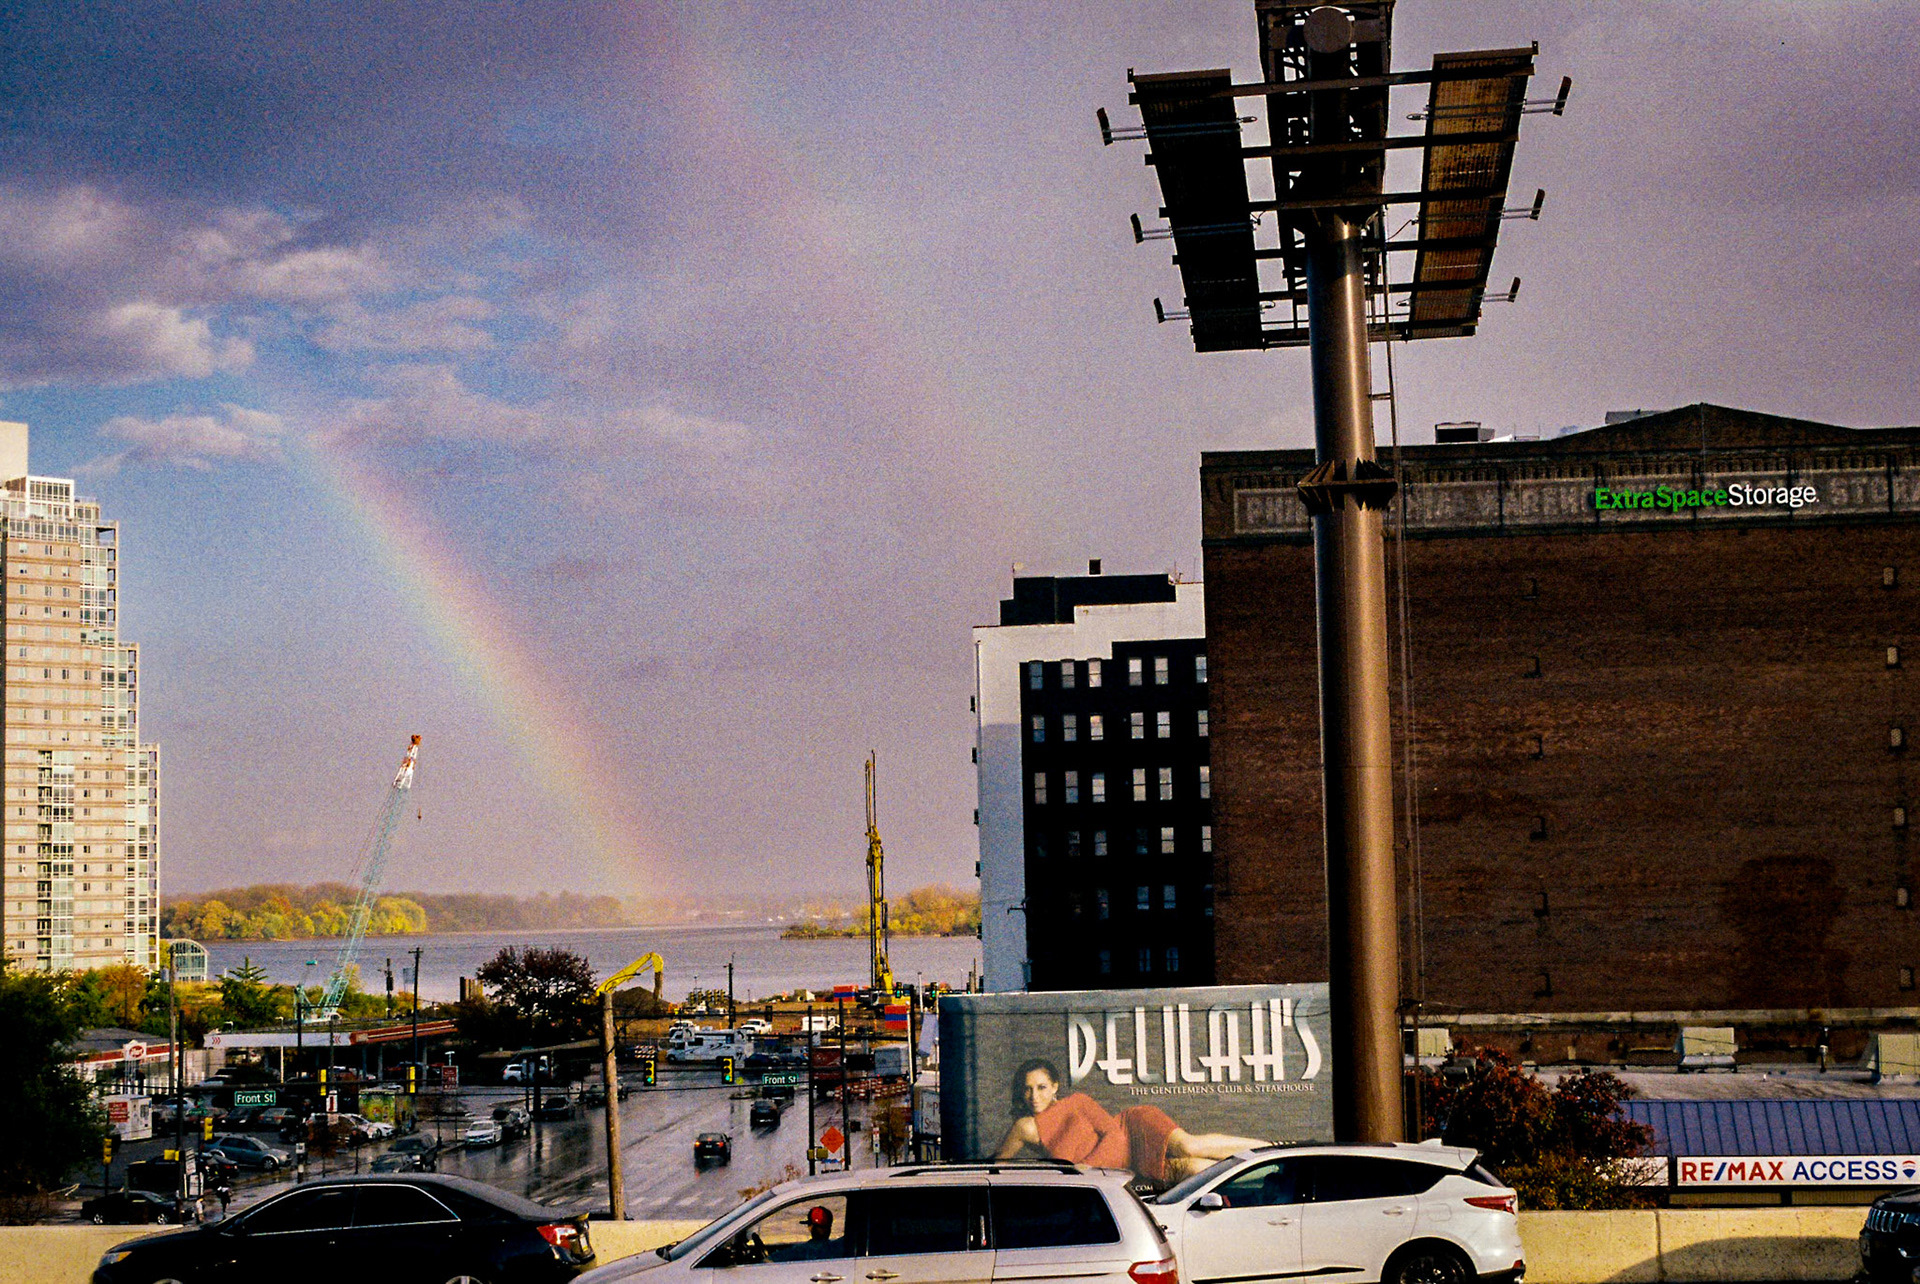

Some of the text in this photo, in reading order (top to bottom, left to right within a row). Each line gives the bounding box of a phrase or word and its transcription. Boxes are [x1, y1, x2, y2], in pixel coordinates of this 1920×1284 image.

[1068, 998, 1322, 1088] DELILAH'S
[765, 1075, 797, 1085] Front St
[1129, 1083, 1316, 1096] THE GENTLEMEN'S CLUB & STEAKHOUSE
[237, 1093, 274, 1103] Front St
[1681, 1160, 1899, 1182] RE/MAX ACCESS
